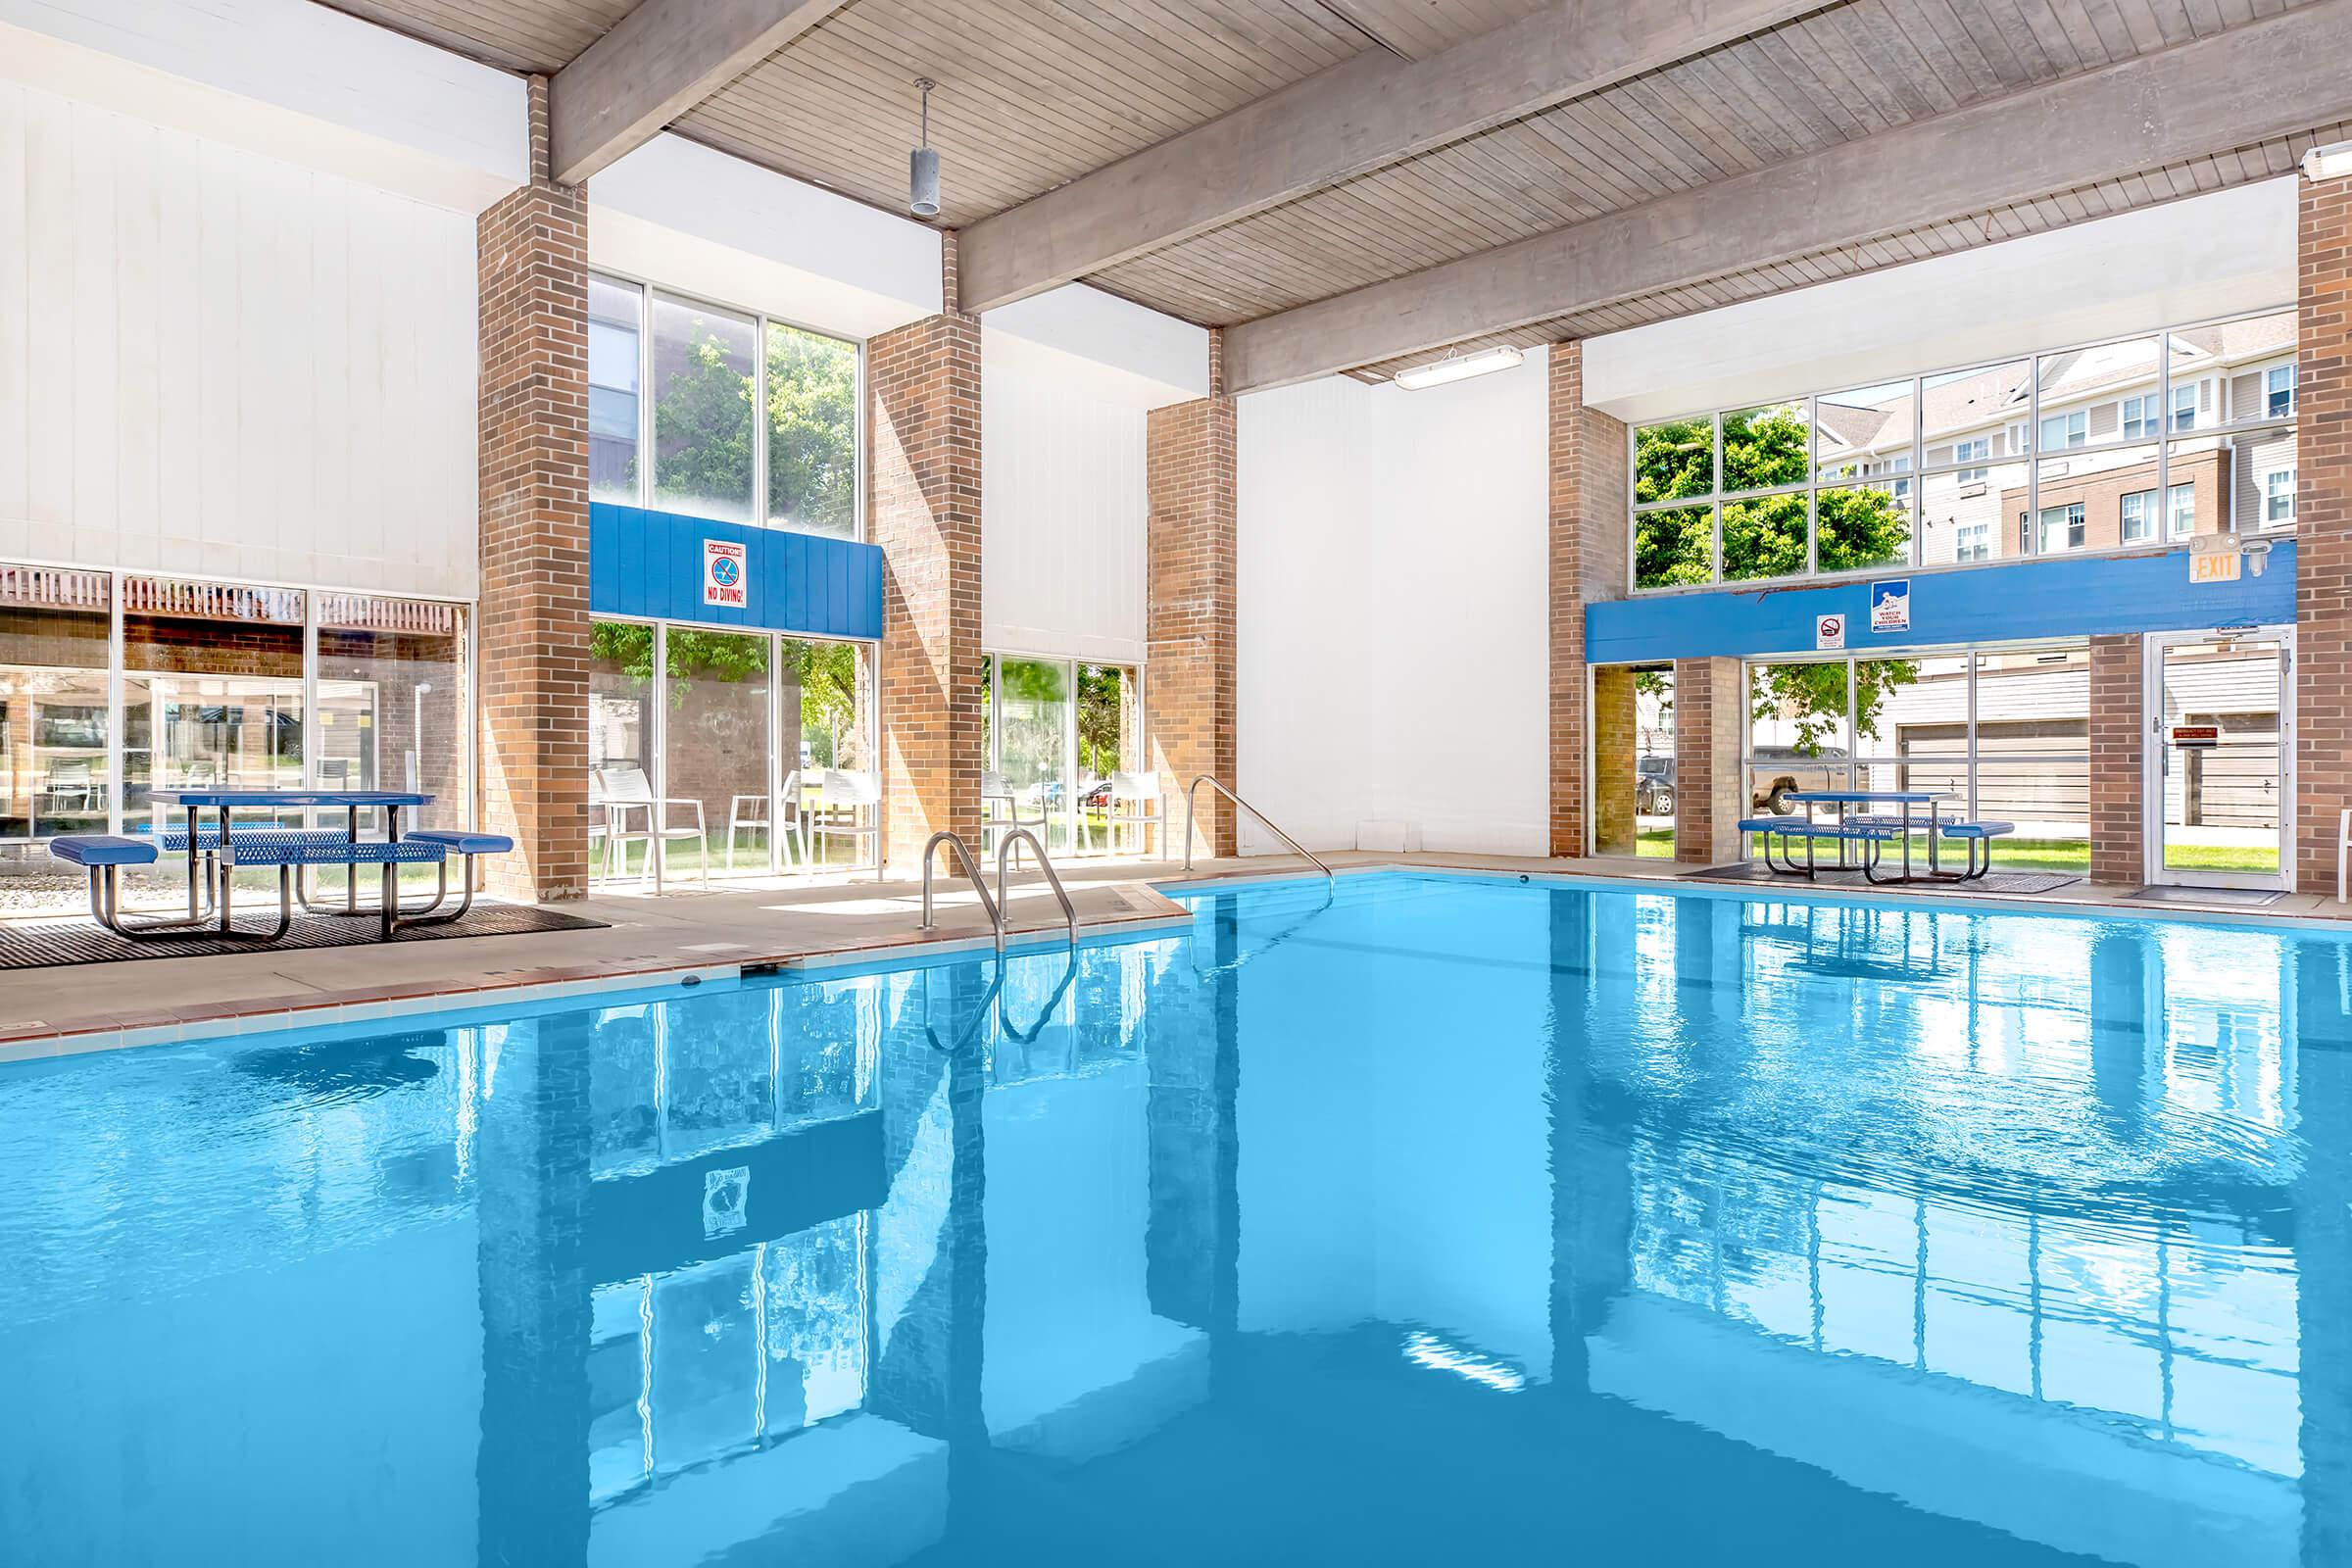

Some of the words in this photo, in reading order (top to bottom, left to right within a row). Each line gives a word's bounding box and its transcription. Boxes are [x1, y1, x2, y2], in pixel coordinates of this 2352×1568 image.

[2197, 555, 2233, 578] EXIT
[708, 587, 718, 600] NO
[720, 588, 743, 603] DIVING!
